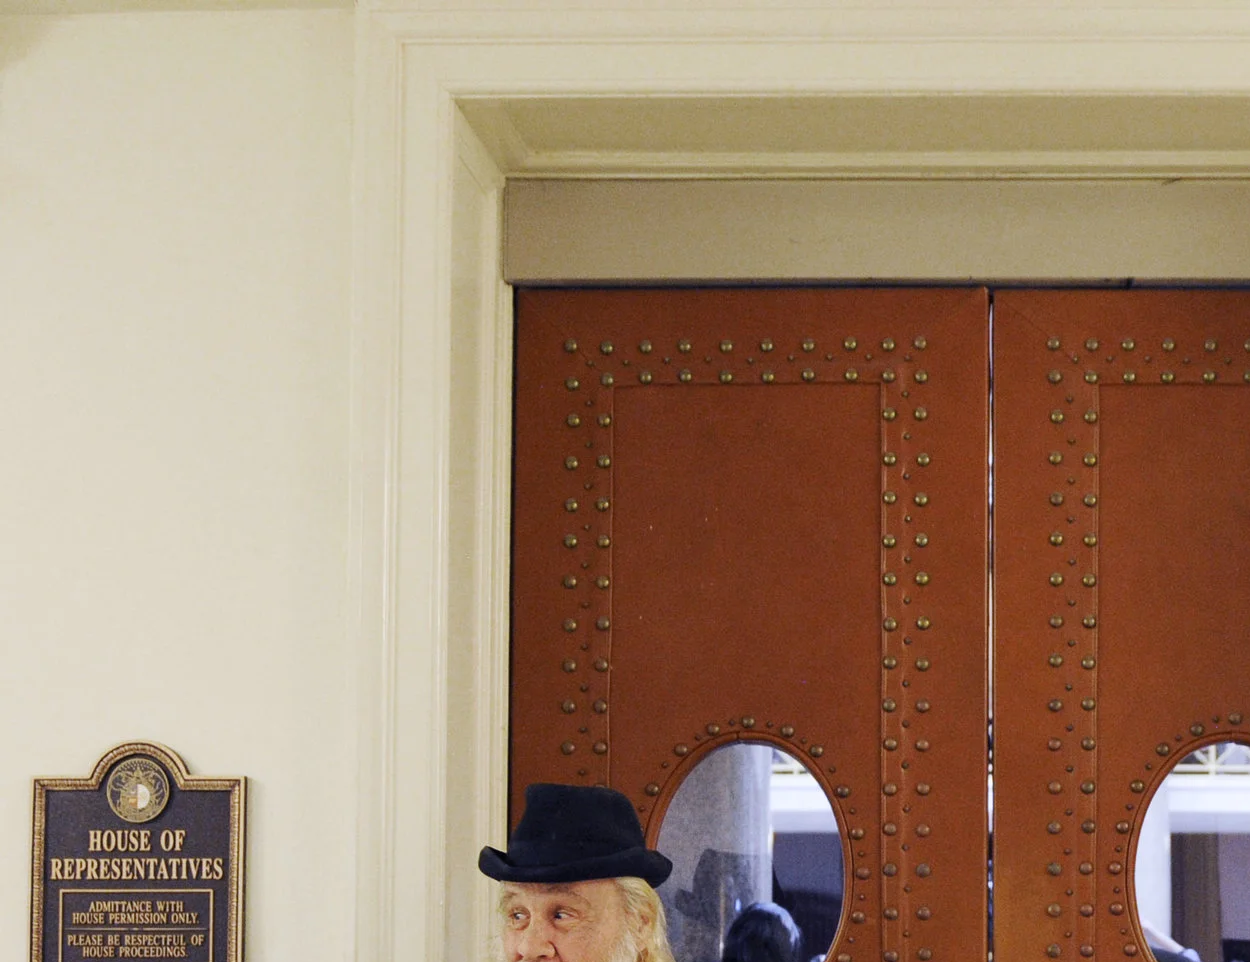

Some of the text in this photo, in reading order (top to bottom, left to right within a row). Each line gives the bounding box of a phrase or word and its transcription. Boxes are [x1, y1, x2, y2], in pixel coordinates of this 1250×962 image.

[88, 830, 186, 851] HOUSE OF
[50, 858, 224, 880] REPRESENTATIVES
[88, 901, 184, 913] ADMITTANCE WITH
[72, 913, 106, 925] HOUSE
[109, 913, 168, 925] PERMISSION
[67, 935, 205, 946] PLEASE BE RESPECTFUL OF
[82, 946, 115, 958] HOUSE
